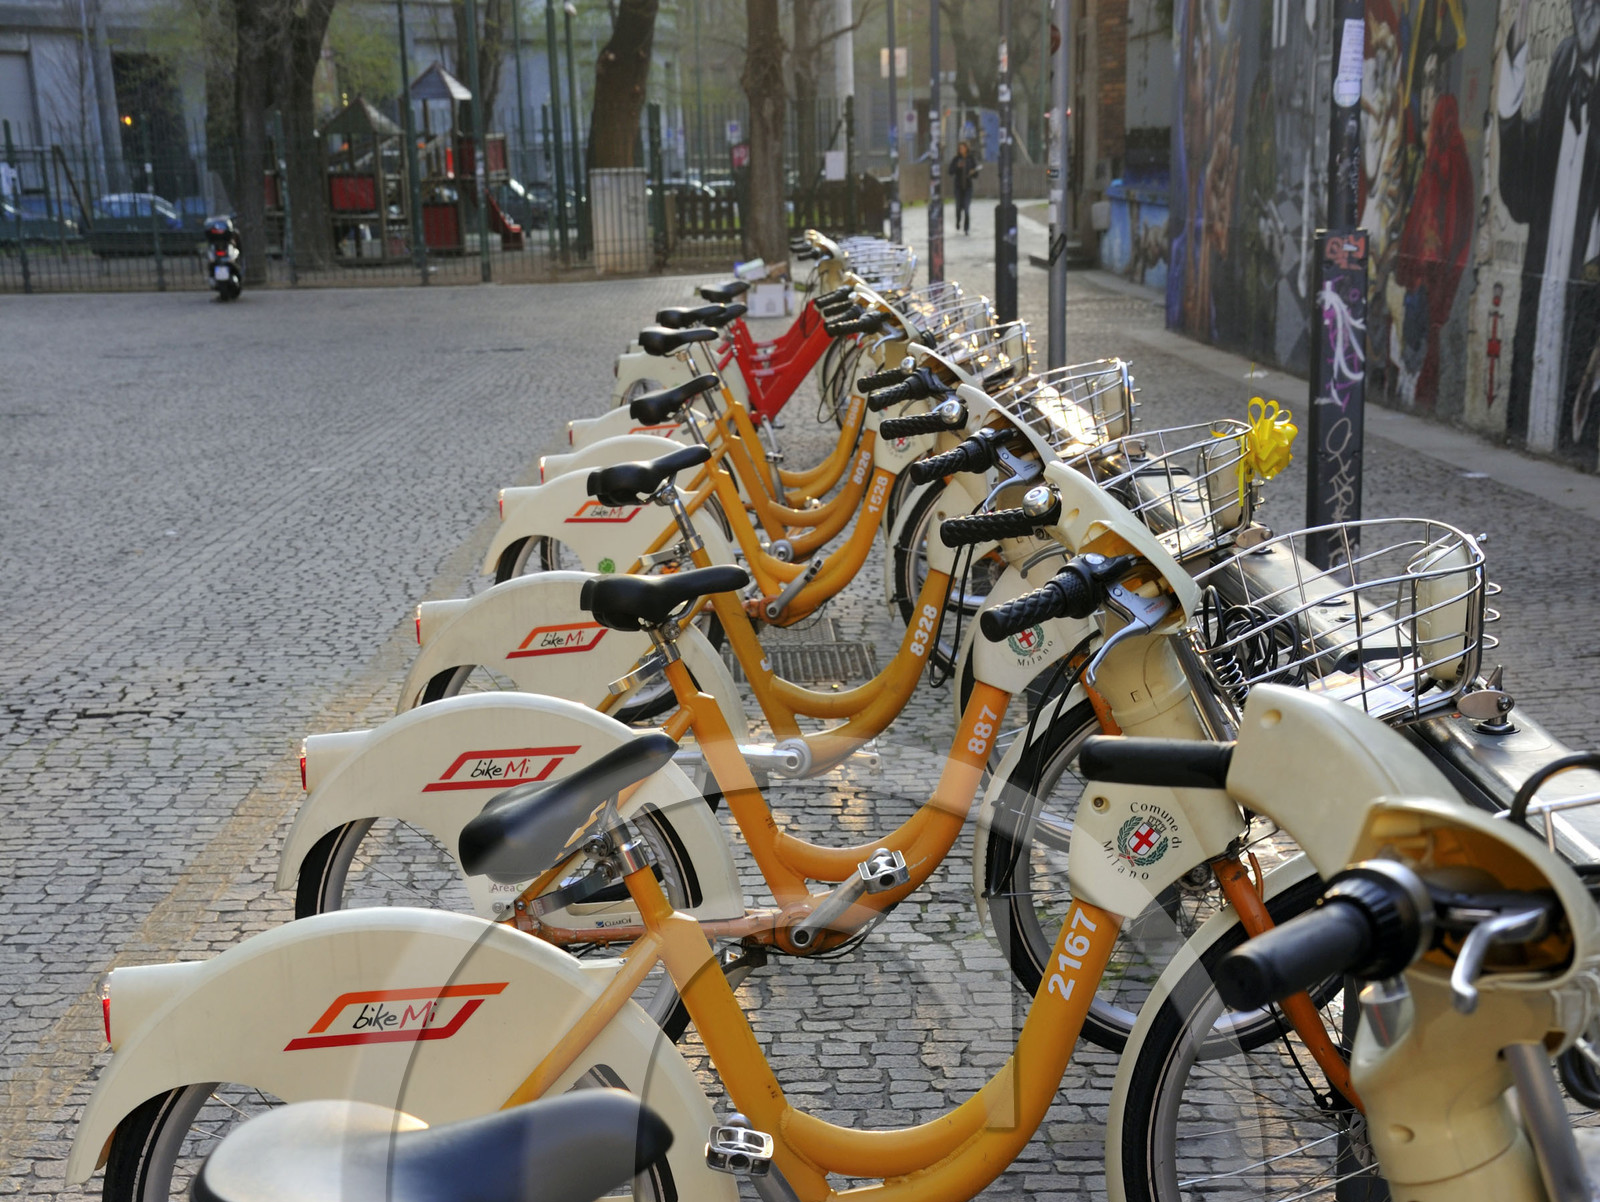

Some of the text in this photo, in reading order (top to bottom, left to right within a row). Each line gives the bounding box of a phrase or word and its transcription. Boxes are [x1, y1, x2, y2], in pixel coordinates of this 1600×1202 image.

[868, 476, 888, 513] 1528
[910, 604, 937, 657] 8328
[1016, 640, 1054, 667] Milano
[967, 704, 998, 755] 887
[1130, 801, 1183, 849] Comune di
[1102, 840, 1149, 881] Milano
[1047, 907, 1097, 1001] 2167
